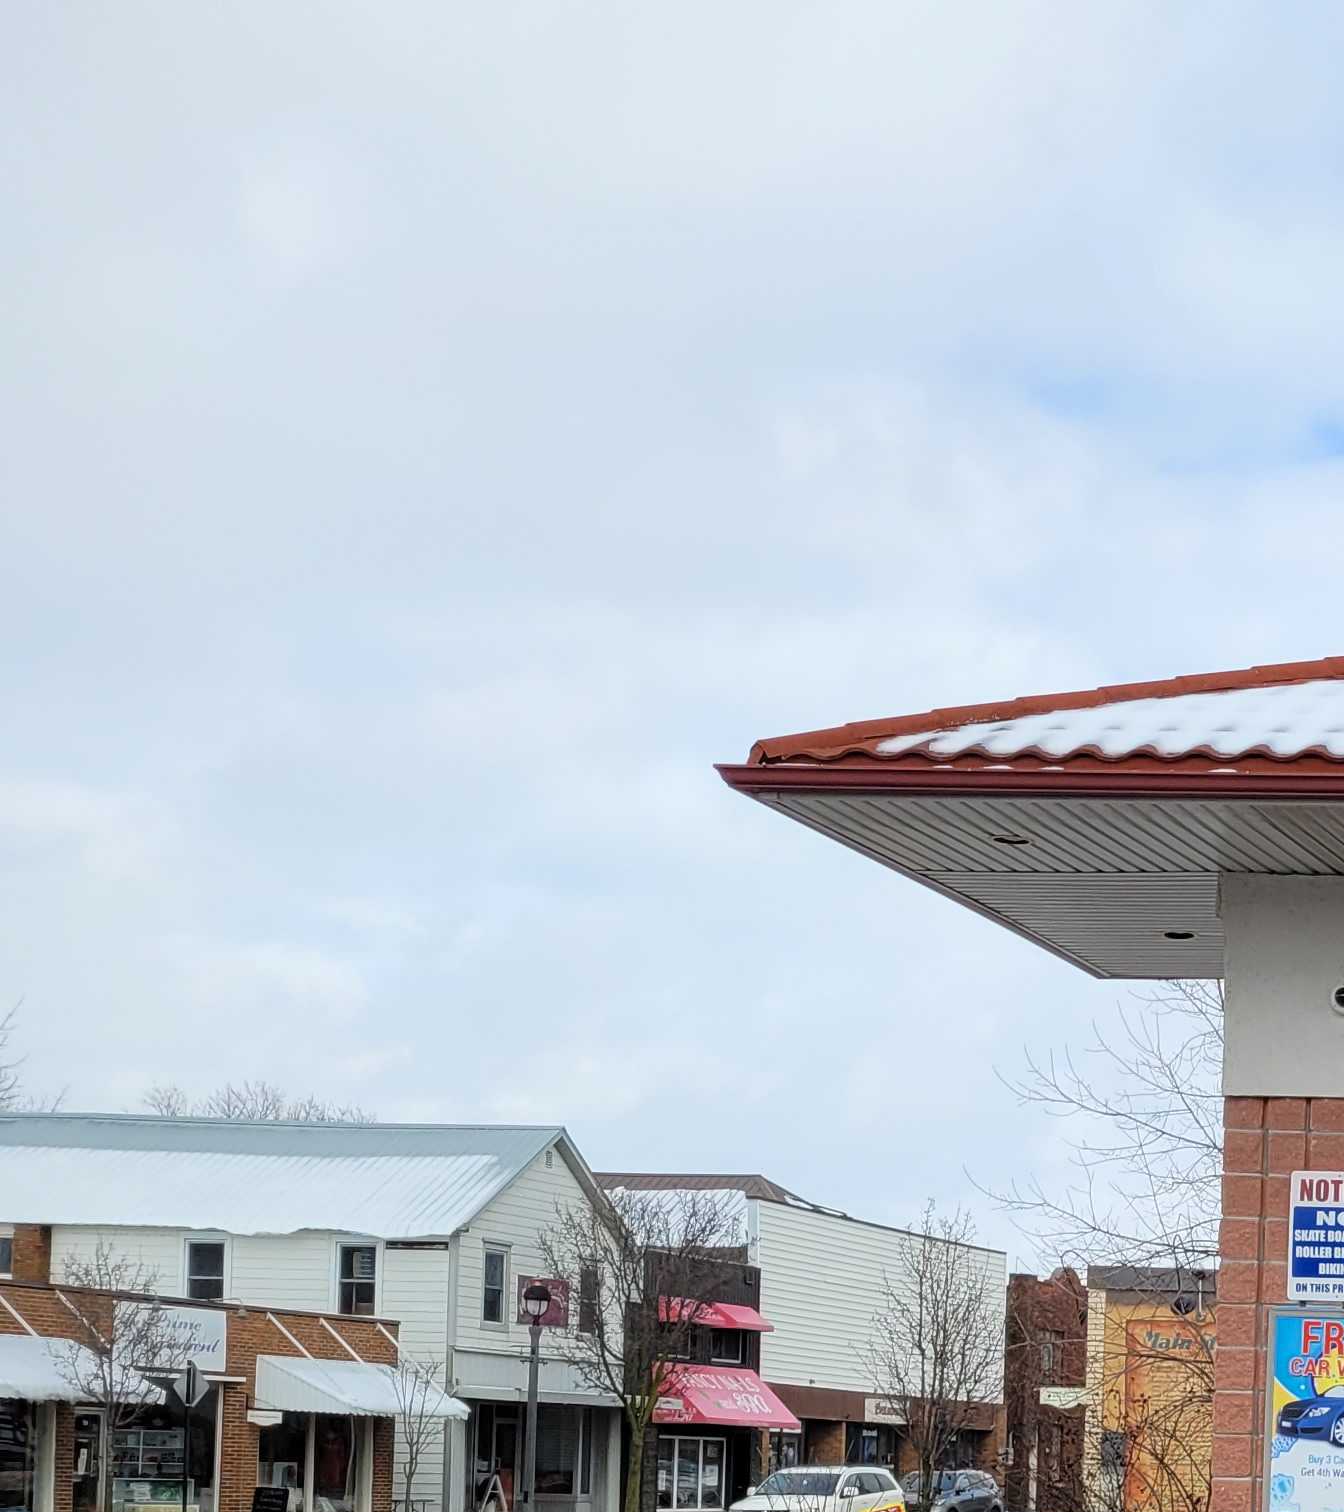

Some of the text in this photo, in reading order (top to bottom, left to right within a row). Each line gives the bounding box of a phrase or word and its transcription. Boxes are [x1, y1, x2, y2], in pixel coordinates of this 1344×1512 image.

[1294, 1229, 1326, 1241] SKATE
[1295, 1246, 1332, 1258] ROLLER
[1295, 1283, 1308, 1292] ON
[1310, 1283, 1330, 1293] THIS
[1290, 1358, 1330, 1377] CAR
[1309, 1454, 1323, 1465] Buy
[1326, 1455, 1331, 1463] 3
[1301, 1467, 1315, 1477] Get
[1317, 1468, 1330, 1477] 4th
